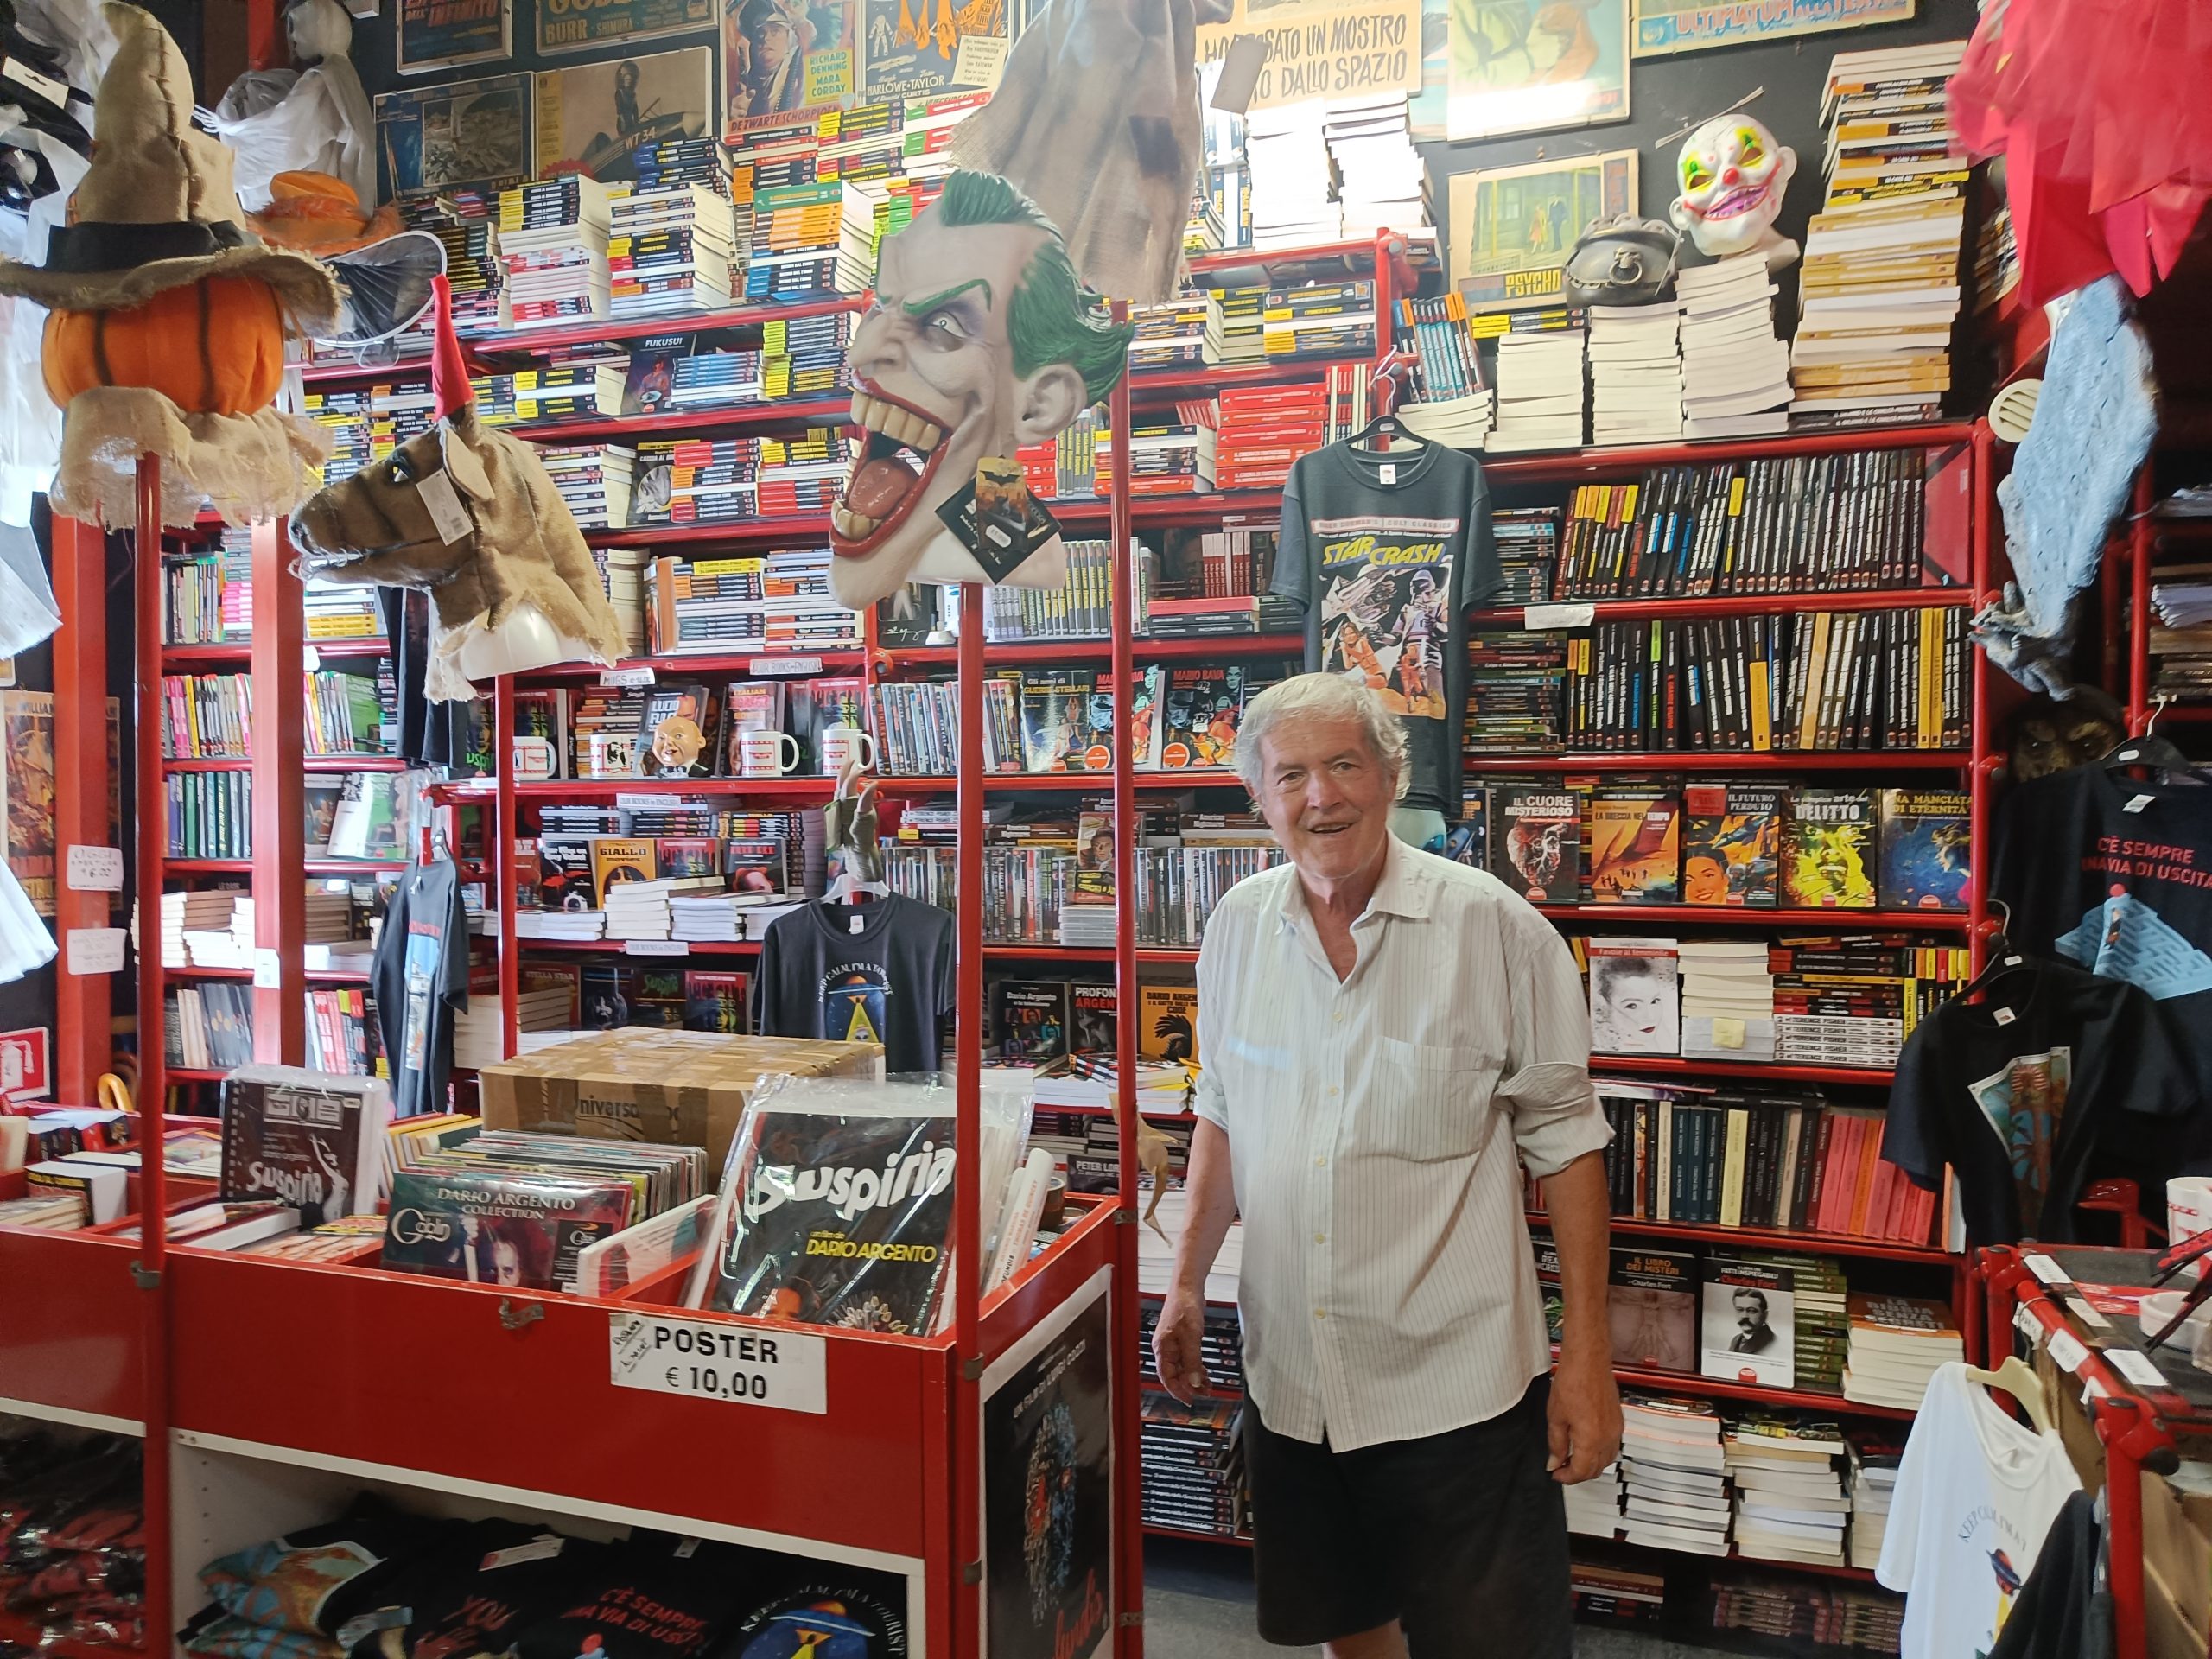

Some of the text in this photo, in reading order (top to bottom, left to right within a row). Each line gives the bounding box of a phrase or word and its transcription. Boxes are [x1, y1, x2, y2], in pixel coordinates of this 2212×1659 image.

[1675, 0, 1794, 35] ULTIMATUM
[545, 17, 633, 44] BURR SHIMURA
[1306, 18, 1327, 56] UN
[1330, 13, 1407, 53] MOSTRO
[810, 51, 848, 66] RICHARD
[810, 63, 848, 76] DENNING
[1281, 59, 1329, 98] DALLO
[1334, 48, 1408, 92] SPAZIO
[816, 73, 842, 85] MARA
[811, 84, 847, 97] CORDAY
[901, 88, 931, 99] CURTIS
[731, 121, 742, 131] DE
[742, 116, 780, 130] ZWARTE
[624, 126, 657, 151] WT 34
[1505, 269, 1560, 296] PSYCHO
[1323, 536, 1444, 566] STAR CRASH
[603, 674, 628, 685] MUGS
[1173, 669, 1225, 681] MARIO BAVA
[1666, 706, 1675, 729] DILUVIO
[1513, 795, 1573, 807] IL CUORE
[1741, 794, 1776, 803] FUTURO
[1833, 794, 1855, 804] arte
[1504, 806, 1573, 817] MISTERIOSO
[1730, 802, 1773, 811] PERDUTO
[1796, 804, 1860, 821] DELITTO
[1894, 804, 1904, 814] DI
[599, 848, 647, 857] GIALLO
[2121, 841, 2196, 865] SEMPRE
[2103, 858, 2131, 874] VIA
[2136, 861, 2153, 876] DI
[2159, 865, 2212, 889] USCITA
[1007, 991, 1057, 1002] Dario Argento
[1075, 987, 1117, 999] PROFON
[1172, 992, 1198, 1001] ARGEN
[1076, 1160, 1102, 1171] PETER
[245, 1160, 325, 1206] Suspiria
[744, 1141, 958, 1222] Suspiria
[437, 1186, 576, 1211] DARIO ARGENTO
[461, 1203, 546, 1220] COLLECTION
[805, 1239, 938, 1262] DARIO ARGENTO
[1625, 1263, 1680, 1276] DEI MISTERI
[1644, 1257, 1672, 1268] LIBRO
[1631, 1279, 1655, 1288] Charles
[1720, 1275, 1777, 1290] Charles Fort
[1873, 1308, 1932, 1322] SENZA
[653, 1325, 779, 1364] POSTER
[665, 1366, 767, 1400] € 10,00
[1957, 1510, 1979, 1544] KEEP
